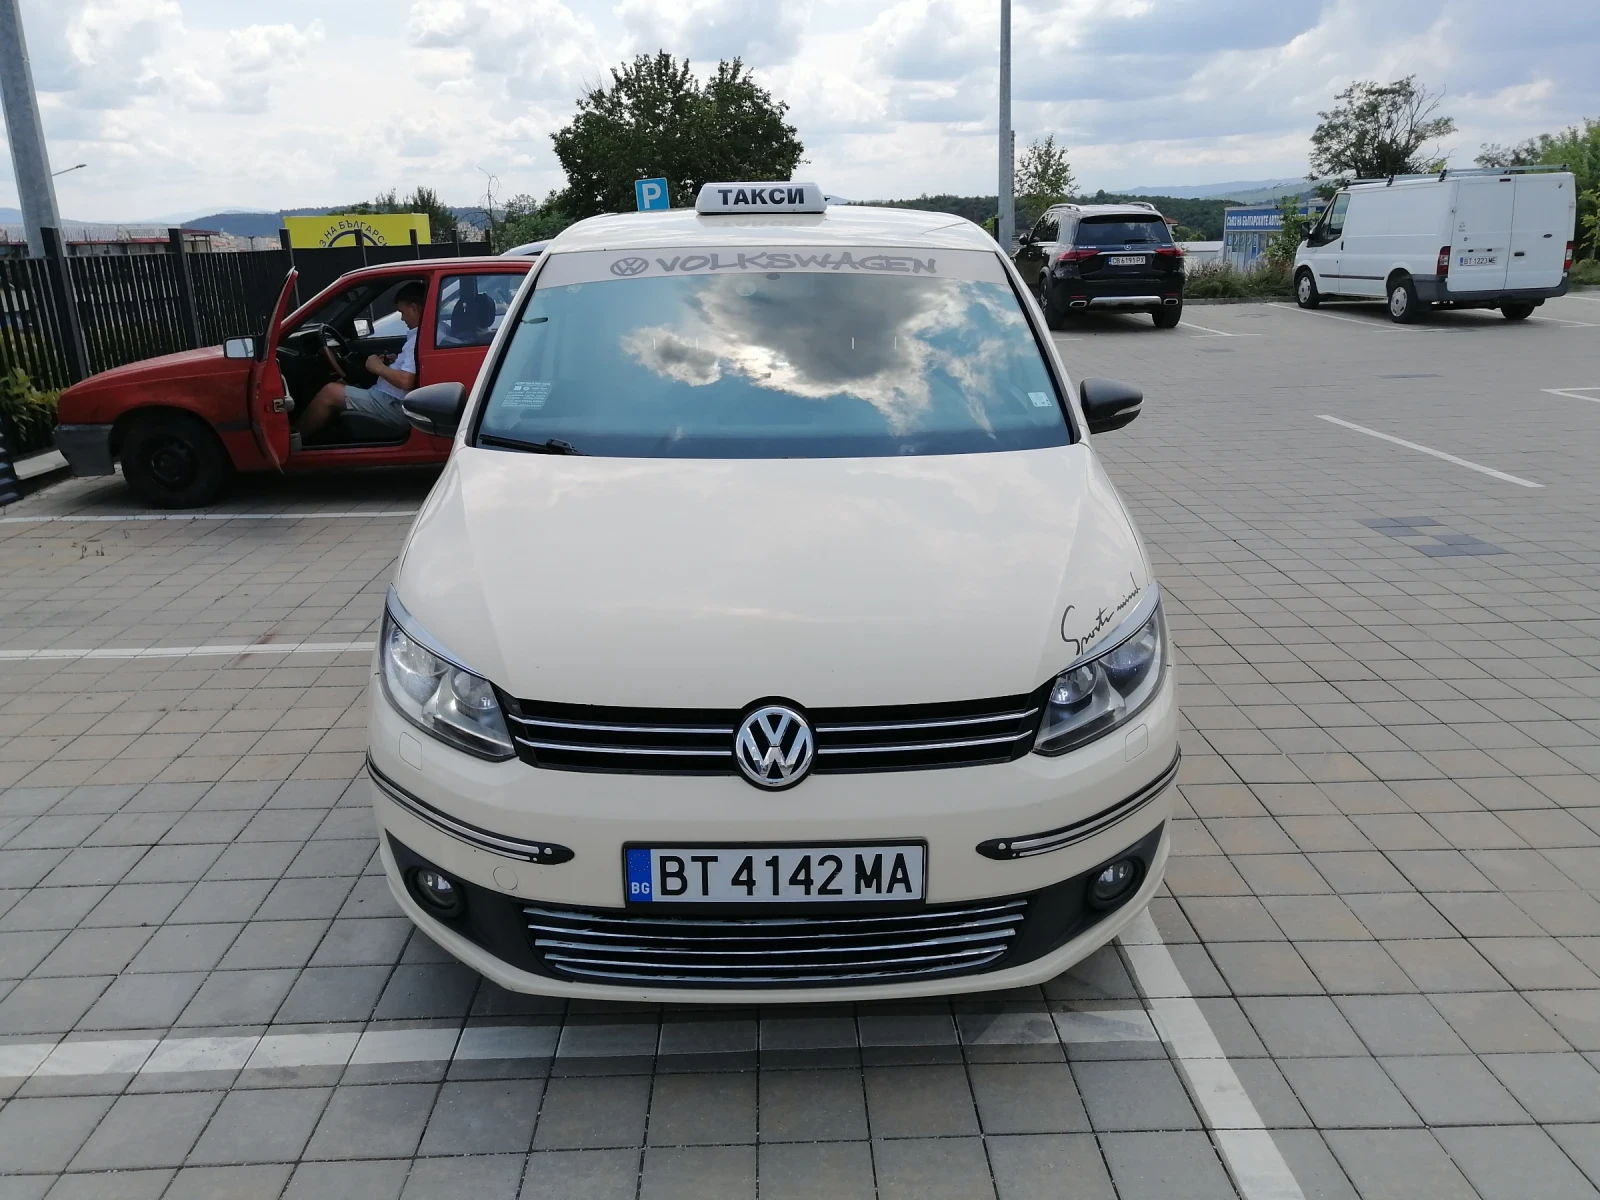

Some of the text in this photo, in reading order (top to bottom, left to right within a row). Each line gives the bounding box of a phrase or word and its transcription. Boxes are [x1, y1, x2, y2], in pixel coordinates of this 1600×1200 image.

[641, 183, 662, 209] P
[717, 188, 805, 206] ТАКСИ
[324, 226, 337, 239] НА
[656, 251, 937, 274] VOLKSWAGEN
[731, 854, 843, 897] 4142
[630, 881, 650, 895] BG
